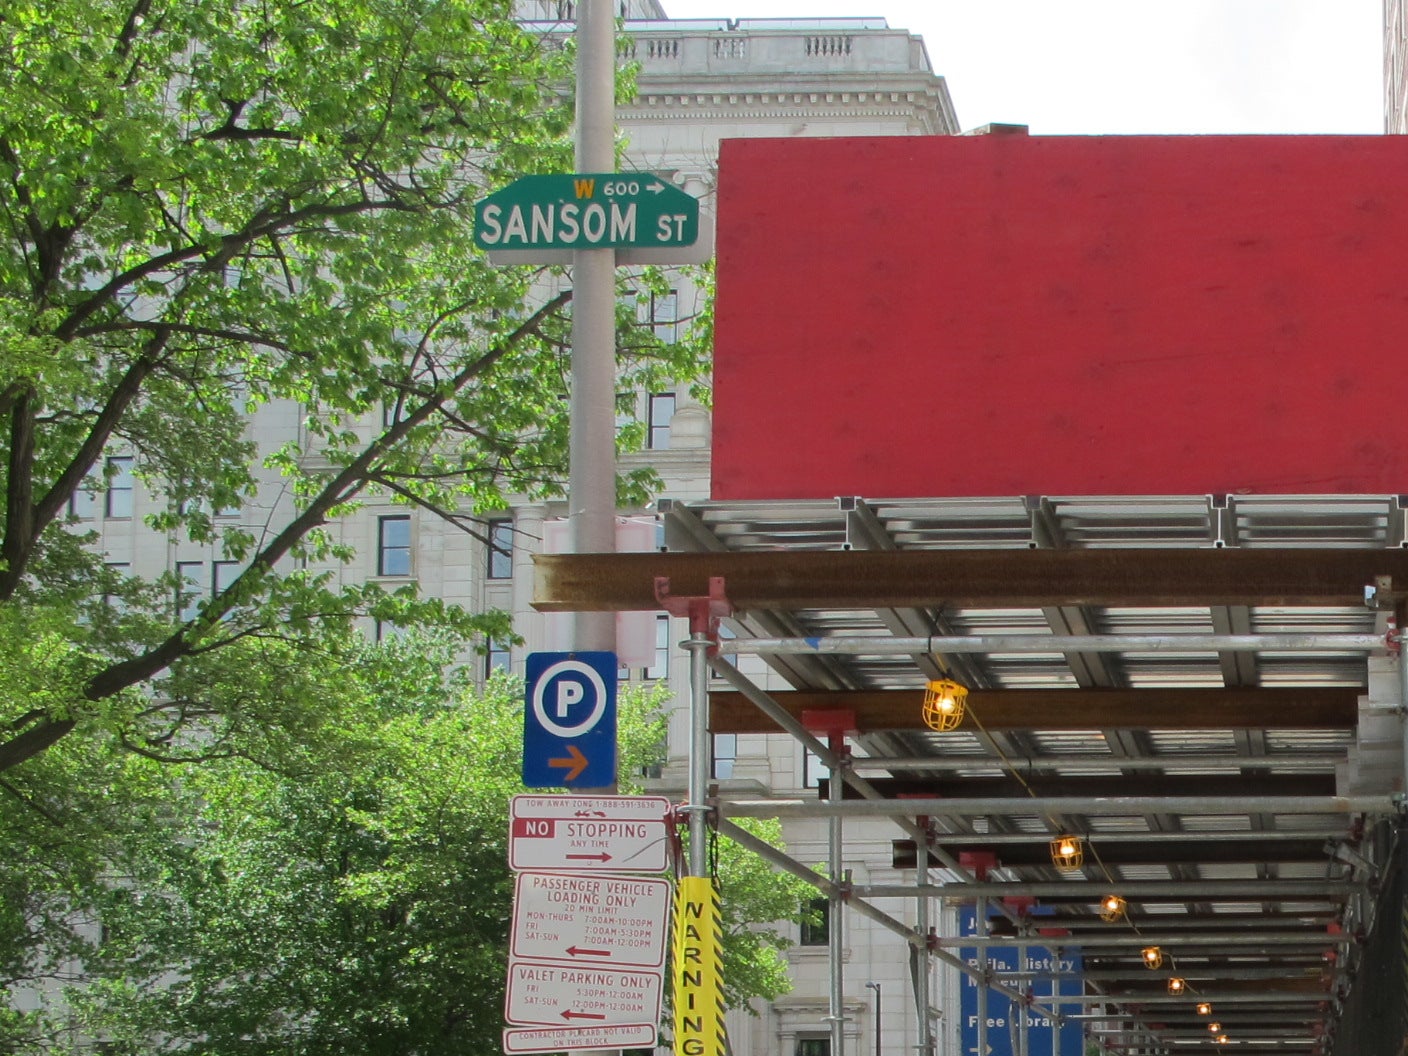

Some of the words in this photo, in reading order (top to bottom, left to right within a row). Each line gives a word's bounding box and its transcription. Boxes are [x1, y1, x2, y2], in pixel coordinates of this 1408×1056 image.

[574, 178, 595, 199] W
[603, 182, 639, 196] 600
[480, 202, 637, 245] SANSOM
[656, 214, 688, 242] ST
[557, 680, 584, 718] P
[526, 800, 543, 808] TOW
[547, 800, 570, 808] AWAY
[572, 800, 593, 809] ZONE
[525, 821, 549, 836] NO
[567, 823, 647, 838] STOPPING
[570, 840, 587, 848] ANY
[591, 840, 609, 848] TIME
[533, 877, 600, 892] PASSENGER
[607, 882, 654, 896] VEHICLE
[547, 891, 600, 905] LOADING
[606, 895, 637, 907] ONLY
[564, 904, 575, 912] 20
[579, 905, 594, 913] MIN
[597, 906, 619, 915] LIMIT
[525, 922, 538, 930] FRI
[520, 969, 555, 982] VALET
[561, 972, 614, 986] PARKING
[620, 976, 652, 989] ONLY
[683, 901, 705, 1056] WARNING
[520, 1031, 566, 1040] CONTRACTOR
[569, 1029, 600, 1038] PLACARD
[604, 1028, 618, 1036] NOT
[621, 1027, 642, 1035] VALID
[553, 1039, 565, 1047] ON
[566, 1039, 582, 1047] THIS
[585, 1038, 609, 1046] BLOCK
